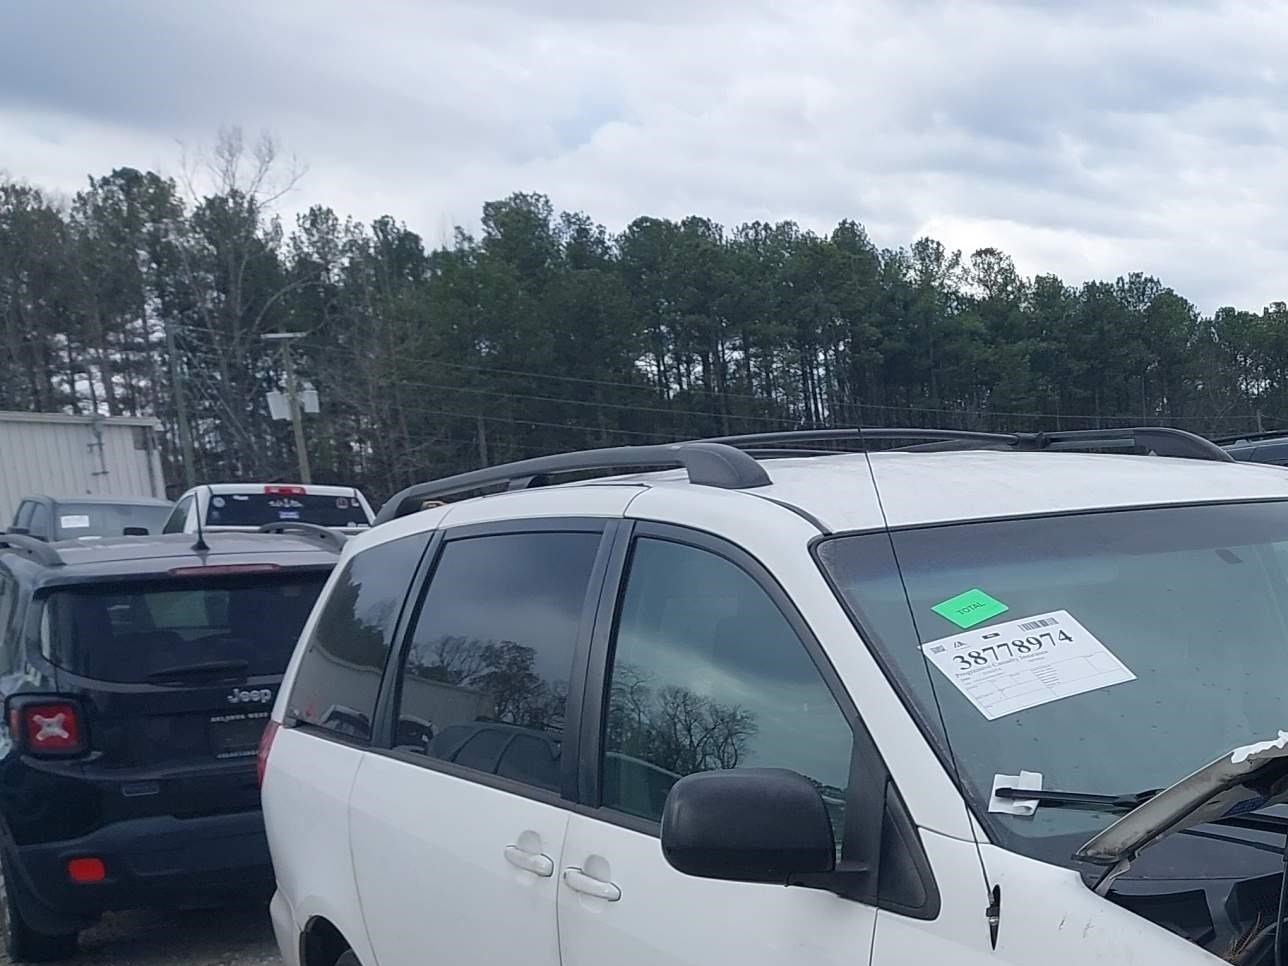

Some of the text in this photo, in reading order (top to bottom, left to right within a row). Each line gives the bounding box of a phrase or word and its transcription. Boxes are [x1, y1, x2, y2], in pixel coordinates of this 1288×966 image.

[955, 601, 986, 615] TOTAL
[953, 630, 1073, 670] 38778974
[226, 688, 272, 704] Jeep
